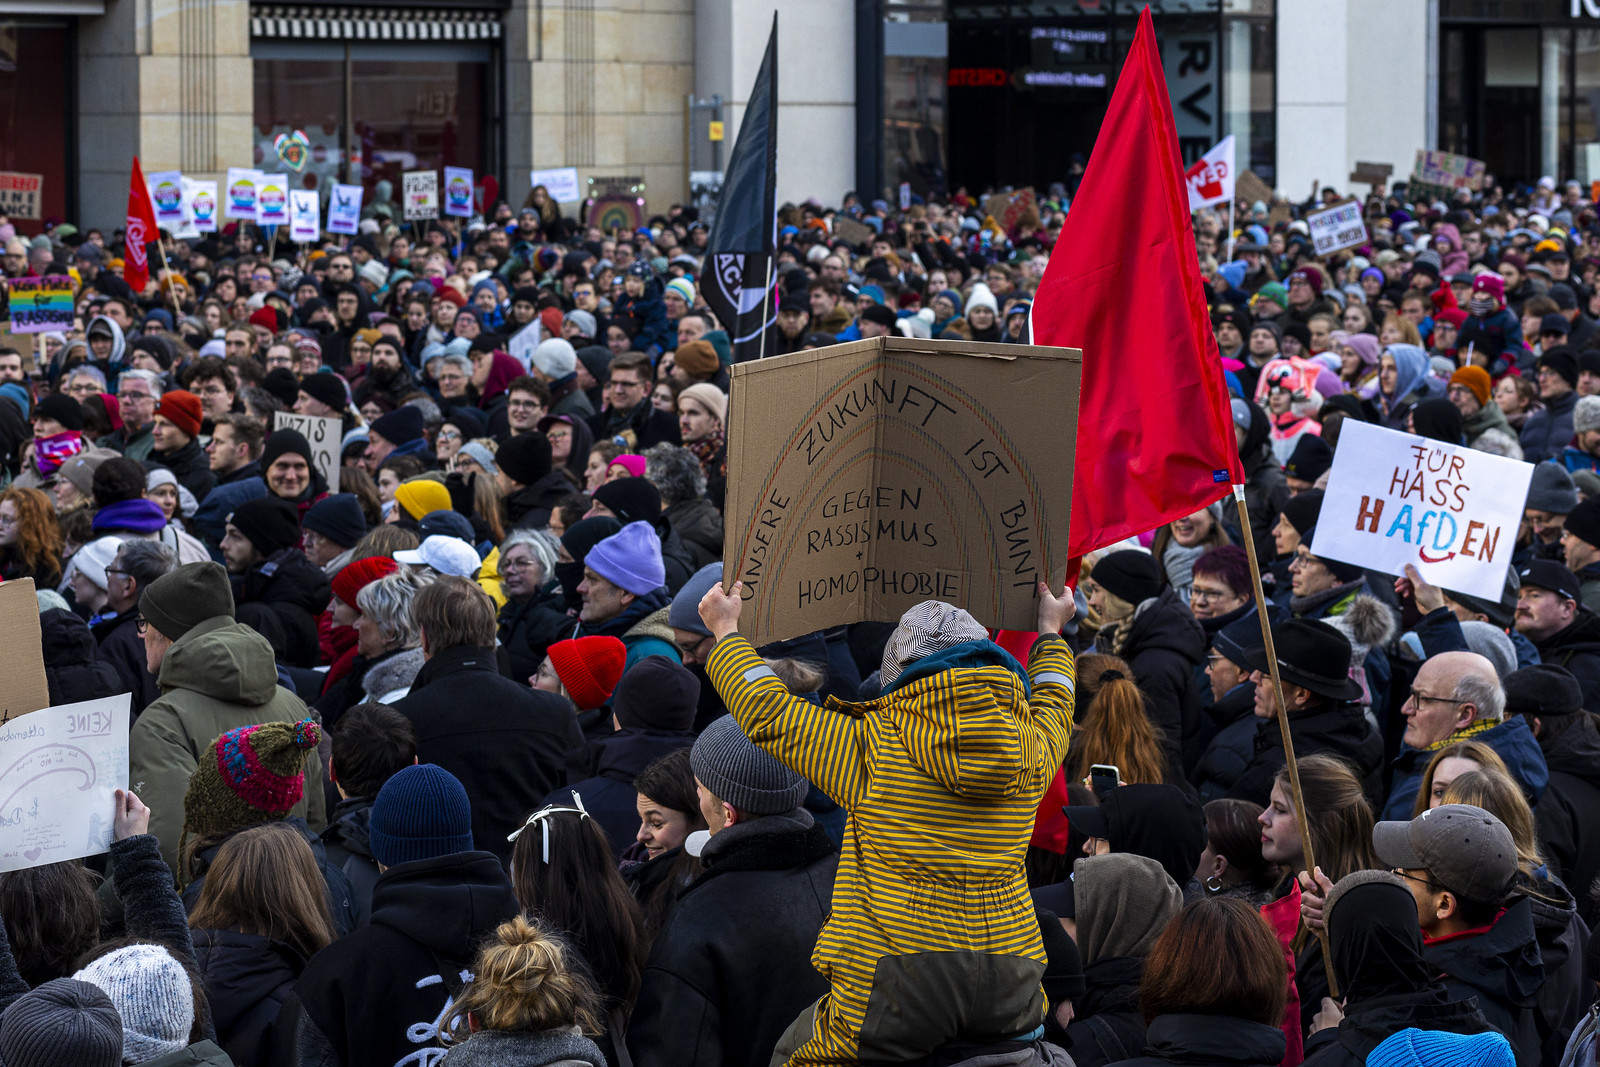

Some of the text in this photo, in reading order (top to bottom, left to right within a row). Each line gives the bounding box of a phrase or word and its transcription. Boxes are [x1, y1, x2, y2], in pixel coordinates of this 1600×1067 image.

[1410, 444, 1465, 481] FÜR
[741, 378, 1039, 602] UNSERE ZUKUNFT IST BUNT
[822, 487, 922, 518] GEGEN
[1388, 466, 1470, 513] HASS
[807, 519, 938, 555] RASSISMUS
[799, 567, 959, 609] HOMOPHOBIE
